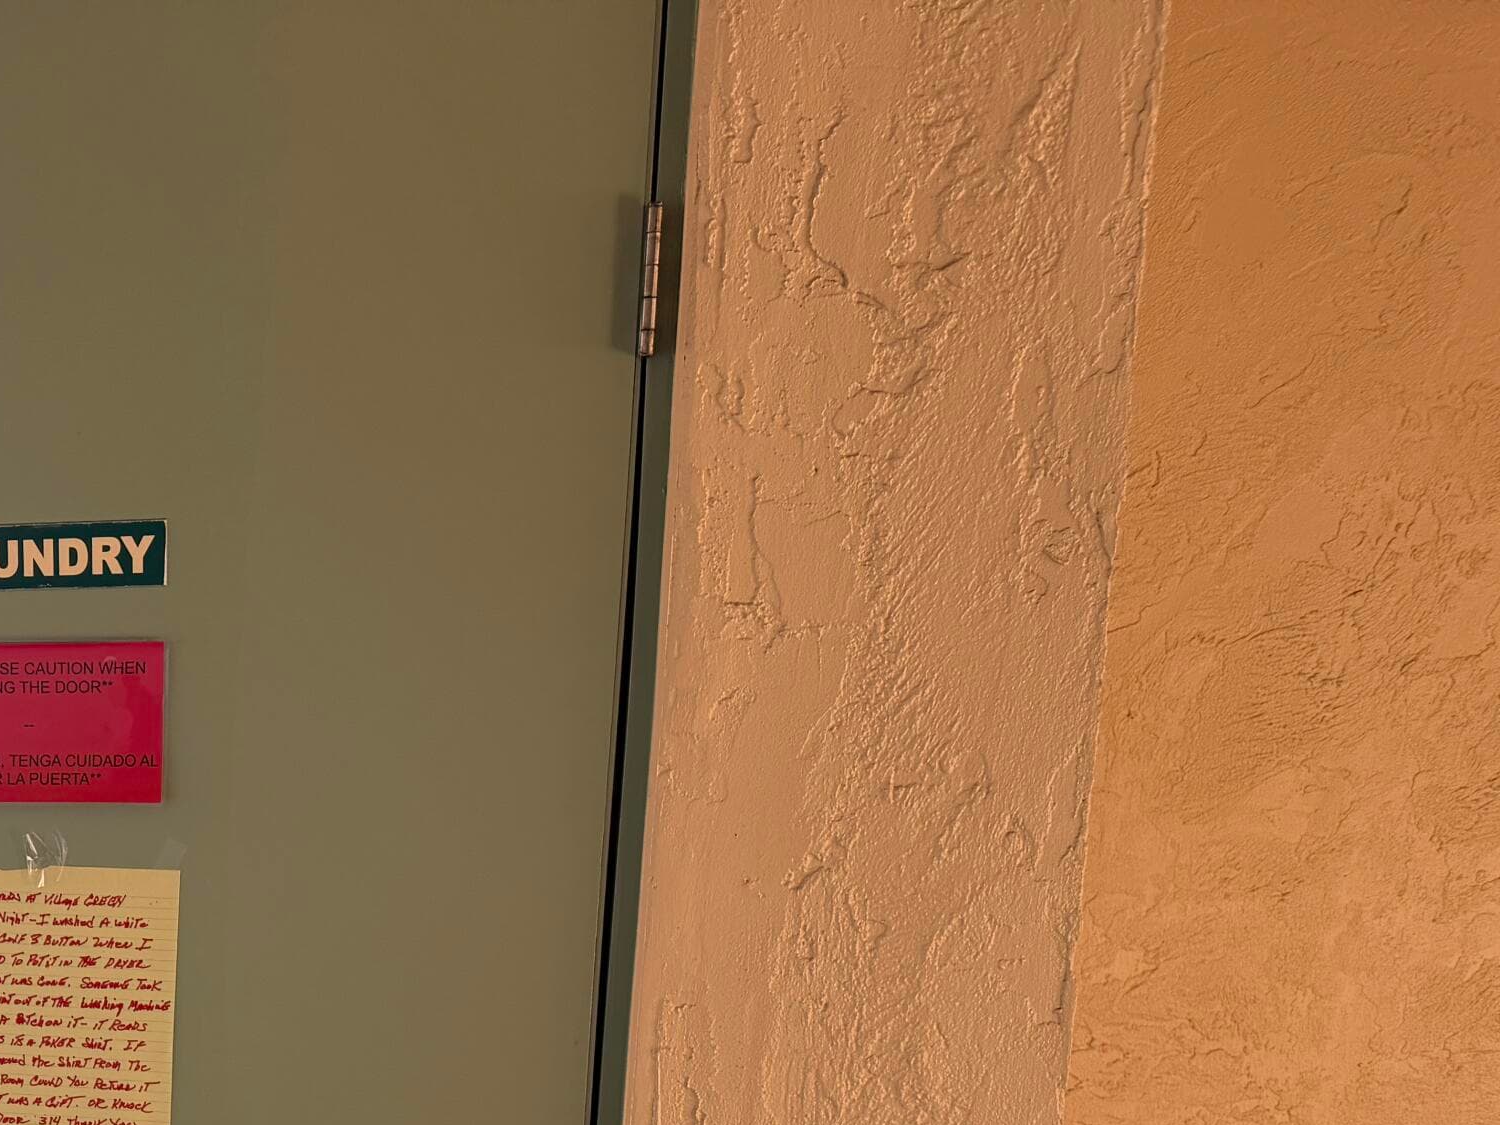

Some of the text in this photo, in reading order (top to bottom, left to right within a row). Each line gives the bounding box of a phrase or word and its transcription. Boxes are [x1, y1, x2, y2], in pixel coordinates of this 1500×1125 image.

[24, 662, 94, 675] CAUTION
[99, 661, 146, 674] WHEN
[22, 681, 50, 693] THE
[10, 754, 62, 767] TENGA
[65, 754, 136, 767] CUIDADO
[140, 754, 158, 767] AL
[7, 773, 26, 785] LA
[135, 938, 153, 951] I
